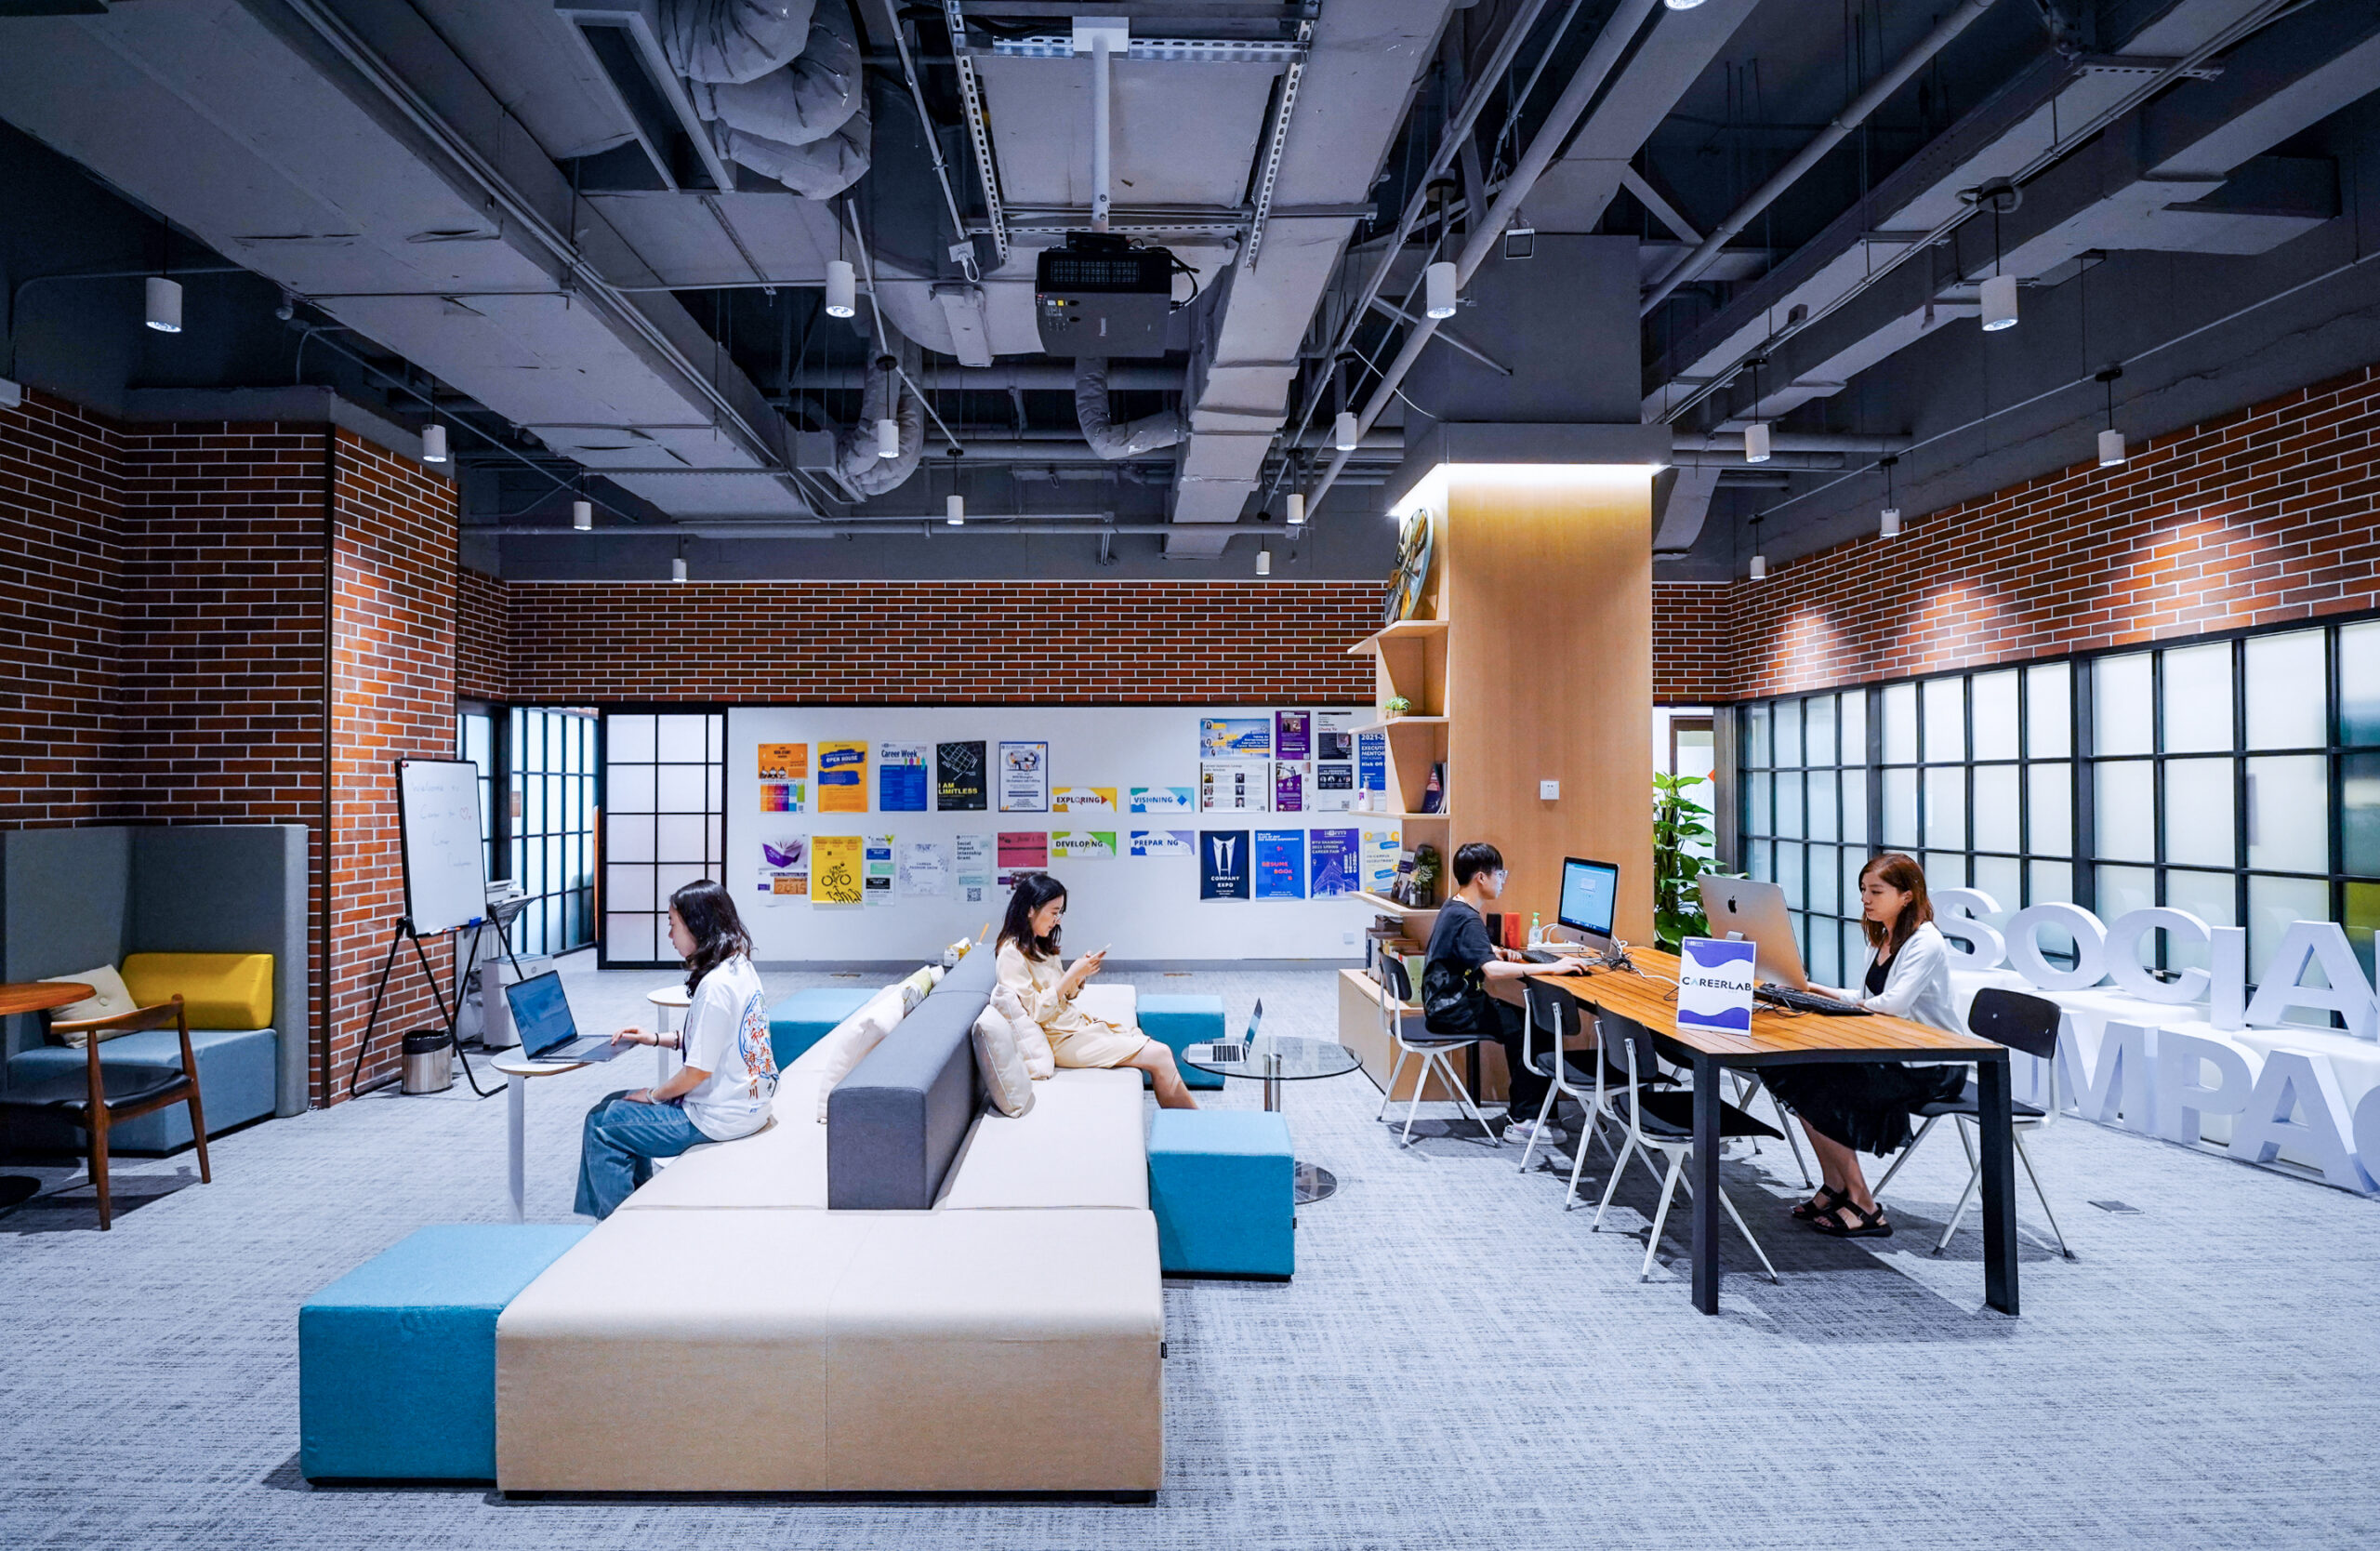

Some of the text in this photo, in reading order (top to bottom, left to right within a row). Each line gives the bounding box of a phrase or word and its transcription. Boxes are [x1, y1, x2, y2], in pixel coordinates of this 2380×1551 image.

[881, 749, 918, 758] Career Week
[1056, 796, 1100, 804] EXPLORING
[1932, 887, 2380, 1042] SOCIA
[1682, 976, 1752, 992] CAREERLAB
